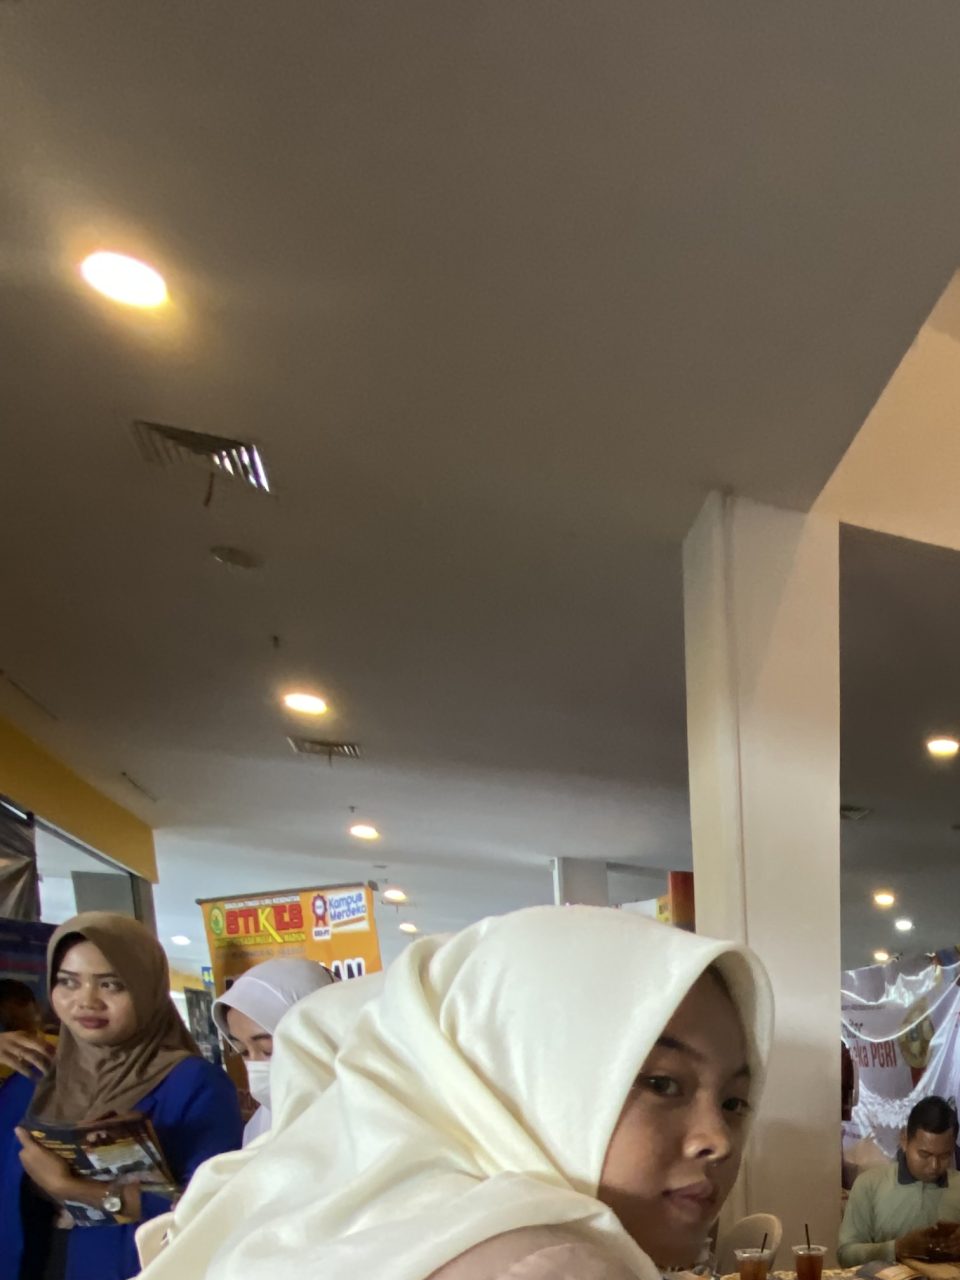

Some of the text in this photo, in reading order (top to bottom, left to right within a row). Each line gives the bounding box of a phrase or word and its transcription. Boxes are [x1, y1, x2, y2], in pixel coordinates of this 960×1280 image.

[328, 893, 362, 908] Kampus
[330, 904, 366, 920] Merdeka
[871, 1041, 897, 1068] PGRI
